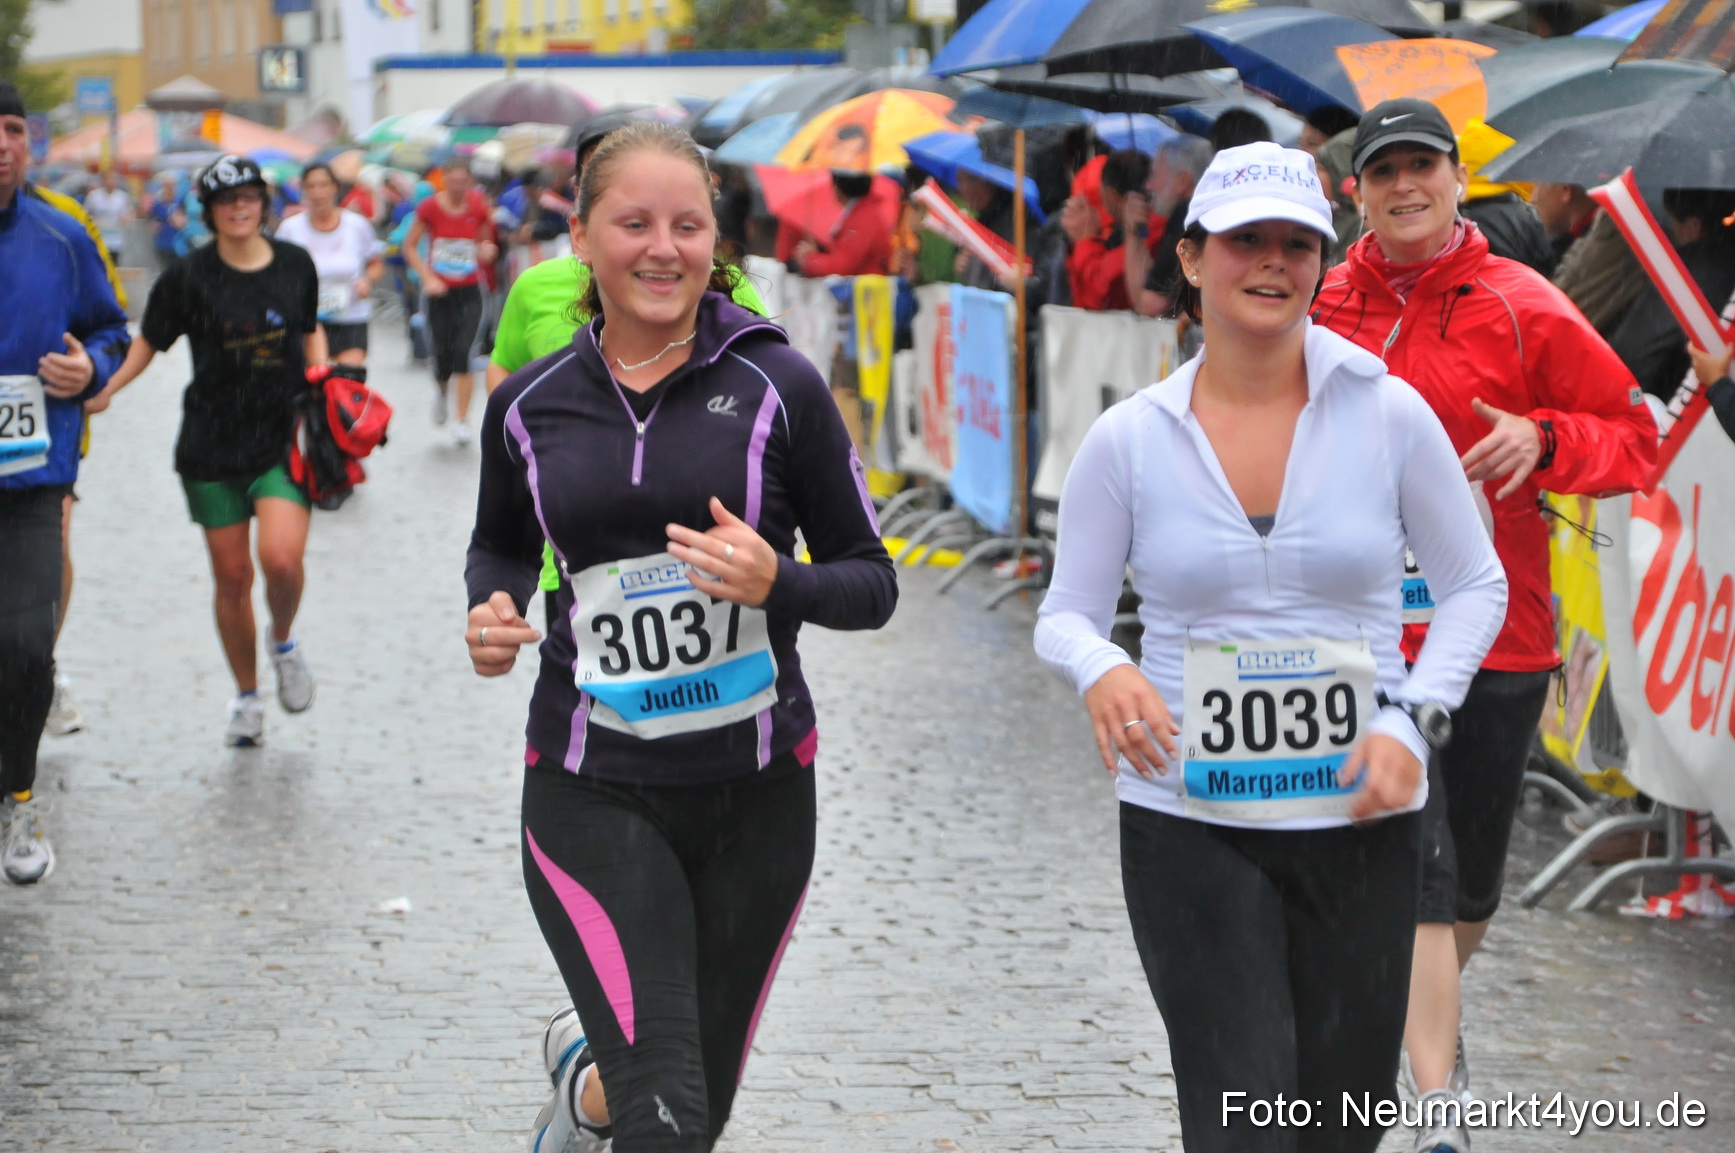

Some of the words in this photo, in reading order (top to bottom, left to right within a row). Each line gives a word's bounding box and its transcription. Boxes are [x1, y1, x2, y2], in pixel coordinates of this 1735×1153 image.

[1223, 164, 1318, 187] EXCELLA
[1401, 584, 1430, 604] ett
[591, 600, 741, 676] 3037
[640, 679, 720, 713] Judith
[1201, 682, 1358, 754] 3039
[1208, 765, 1353, 799] Margareth
